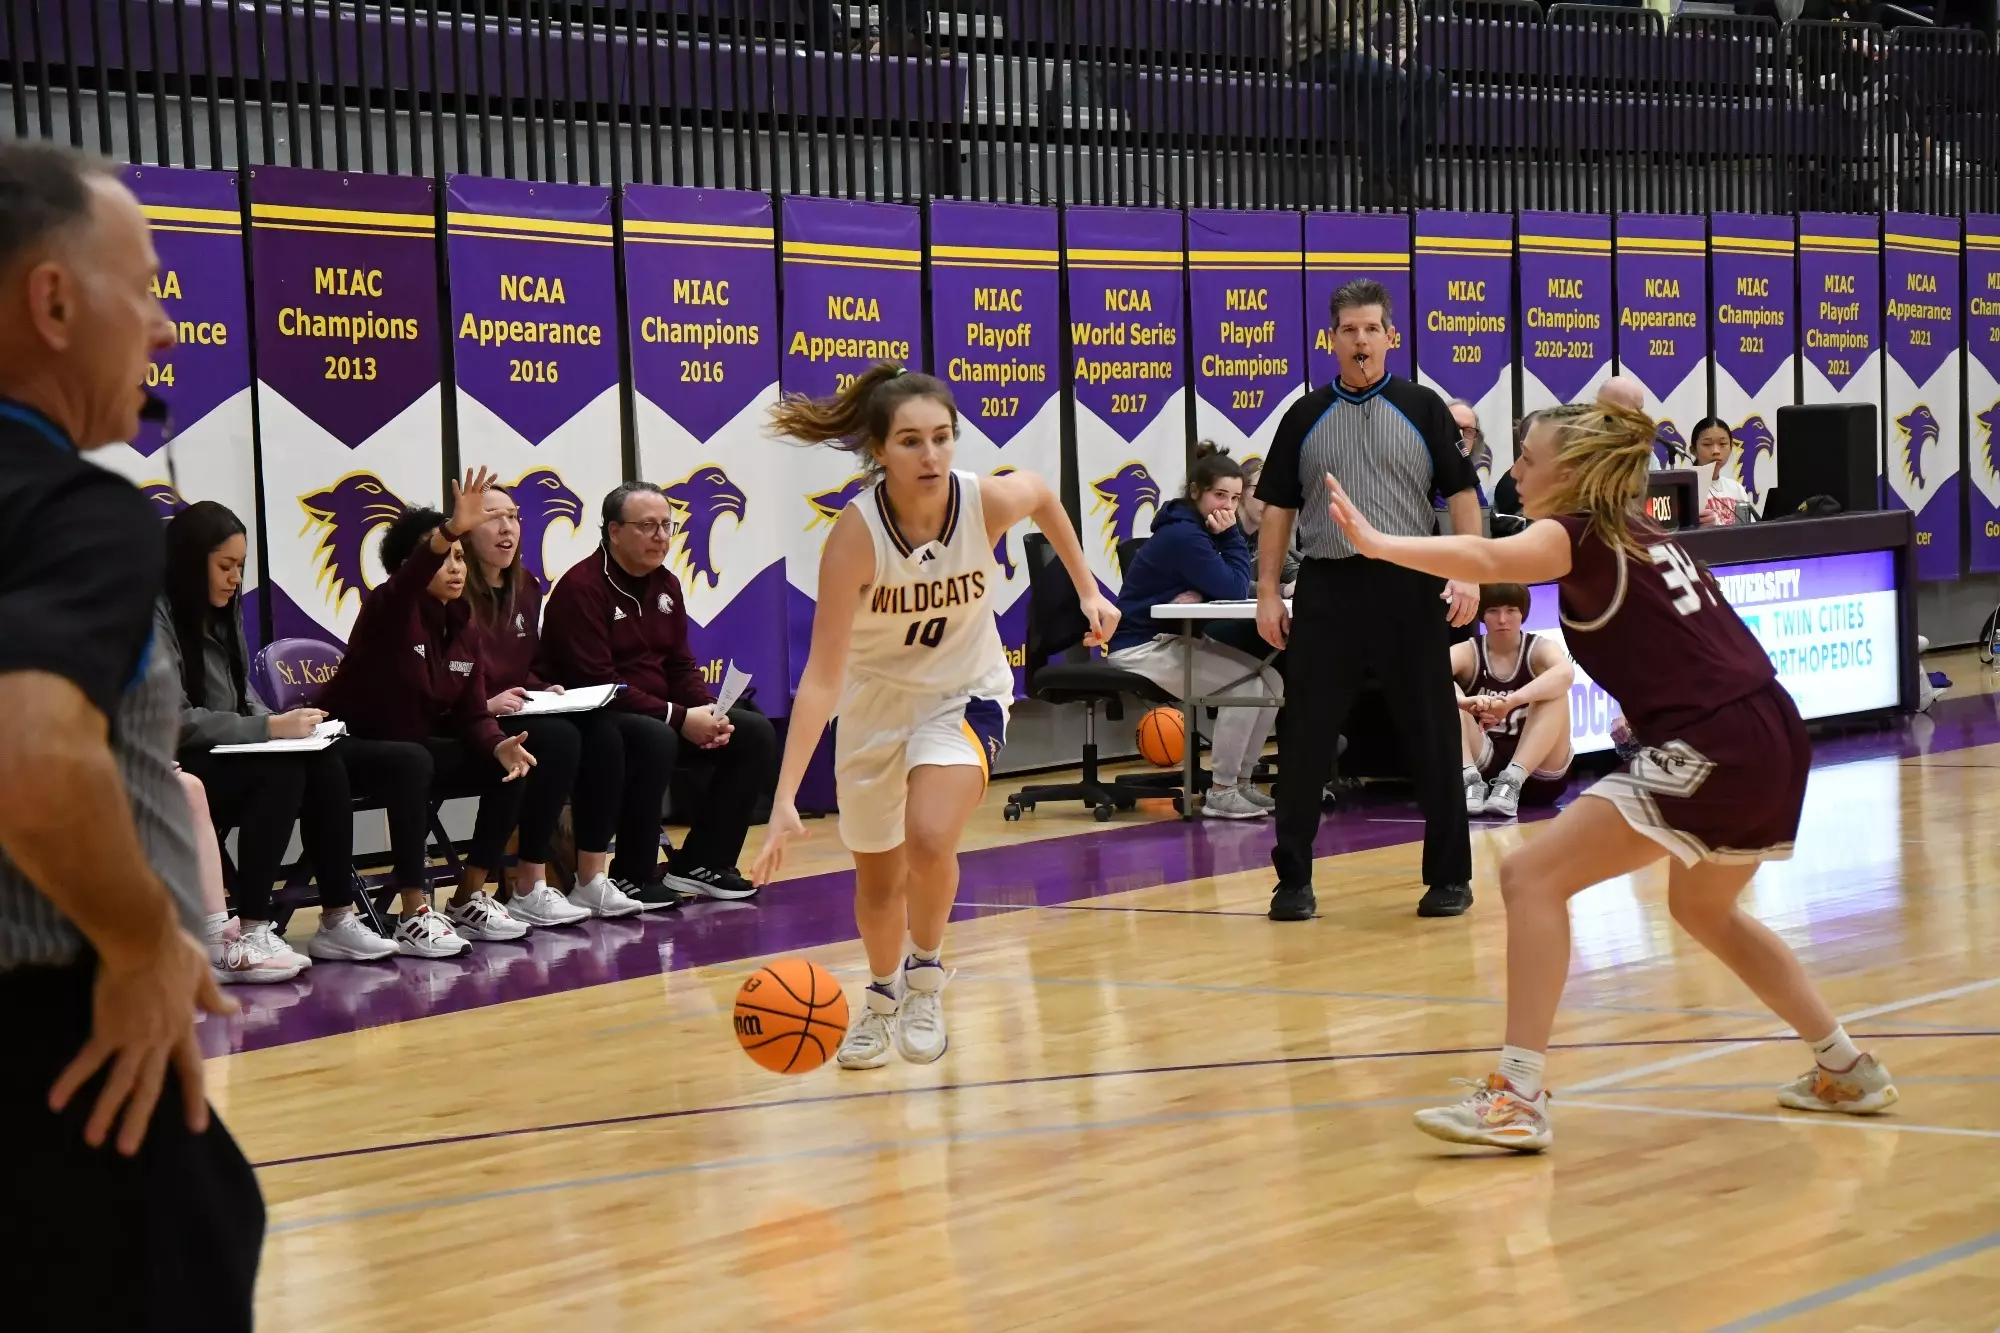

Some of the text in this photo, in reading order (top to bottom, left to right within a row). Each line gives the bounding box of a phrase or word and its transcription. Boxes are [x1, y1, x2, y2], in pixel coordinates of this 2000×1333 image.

[148, 270, 183, 300] AA
[315, 267, 383, 297] MIAC
[500, 274, 566, 304] NCAA
[673, 279, 729, 306] MIAC
[1448, 280, 1486, 302] MIAC
[1548, 278, 1583, 300] MIAC
[1645, 278, 1680, 298] NCAA
[1737, 277, 1769, 297] MIAC
[1824, 274, 1855, 294] MIAC
[1907, 273, 1937, 293] NCAA
[828, 295, 881, 322] NCAA
[974, 287, 1023, 313] MIAC
[1105, 288, 1152, 312] NCAA
[1226, 288, 1268, 311] MIAC
[1886, 298, 1952, 321] Appearance
[1427, 310, 1506, 336] Champions
[1527, 307, 1600, 333] Champions
[1620, 307, 1697, 331] Appearance
[1718, 304, 1785, 328] Champions
[1819, 301, 1860, 325] Playoff
[278, 307, 418, 345] Champions
[458, 312, 602, 347] Appearance
[641, 316, 759, 350] Champions
[967, 322, 1032, 353] Playoff
[1070, 322, 1177, 346] World Series
[1220, 320, 1275, 349] Playoff
[1909, 329, 1932, 346] 2021
[788, 331, 909, 363] Appearance
[1534, 340, 1594, 359] 2020-2021
[1649, 339, 1675, 356] 2021
[1739, 336, 1764, 353] 2021
[1806, 328, 1869, 351] Champions
[1452, 345, 1482, 363] 2020
[145, 362, 175, 387] 04
[324, 356, 377, 381] 2013
[509, 359, 559, 384] 2016
[680, 360, 724, 383] 2016
[948, 357, 1046, 388] Champions
[1074, 357, 1172, 385] Appearance
[1201, 354, 1288, 382] Champions
[1827, 359, 1851, 376] 2021
[835, 373, 861, 394] 20
[981, 397, 1019, 417] 2017
[1111, 393, 1147, 413] 2017
[1232, 390, 1265, 409] 2017
[1652, 495, 1672, 521] POSS
[871, 570, 985, 613] WILDCATS
[904, 616, 948, 648] 10
[1773, 601, 1865, 639] TWIN CITIES
